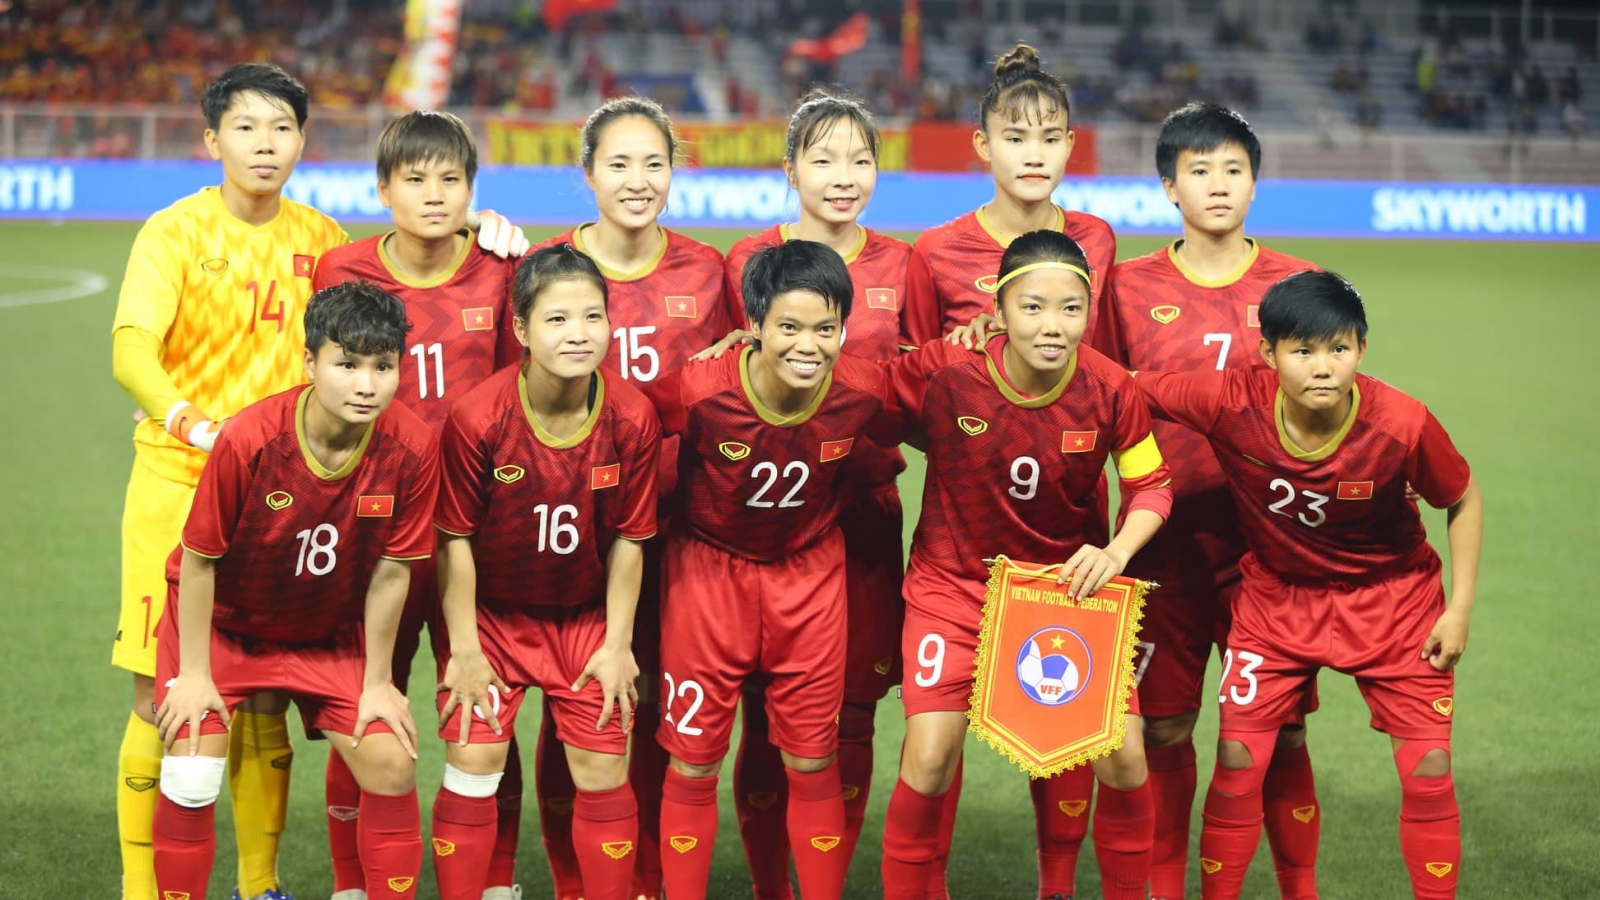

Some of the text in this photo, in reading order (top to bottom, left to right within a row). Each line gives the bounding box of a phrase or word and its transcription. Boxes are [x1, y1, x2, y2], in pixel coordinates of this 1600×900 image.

[1372, 188, 1586, 234] SKYWORTH
[246, 280, 285, 335] 14
[410, 343, 446, 399] 11
[613, 326, 660, 382] 15
[1203, 333, 1232, 371] 7
[746, 461, 810, 508] 22
[1008, 456, 1040, 500] 9
[1268, 478, 1330, 528] 23
[295, 523, 339, 576] 18
[533, 504, 580, 555] 16
[1011, 586, 1041, 603] VIETNAM
[914, 633, 946, 687] 9
[1040, 684, 1063, 696] VFF
